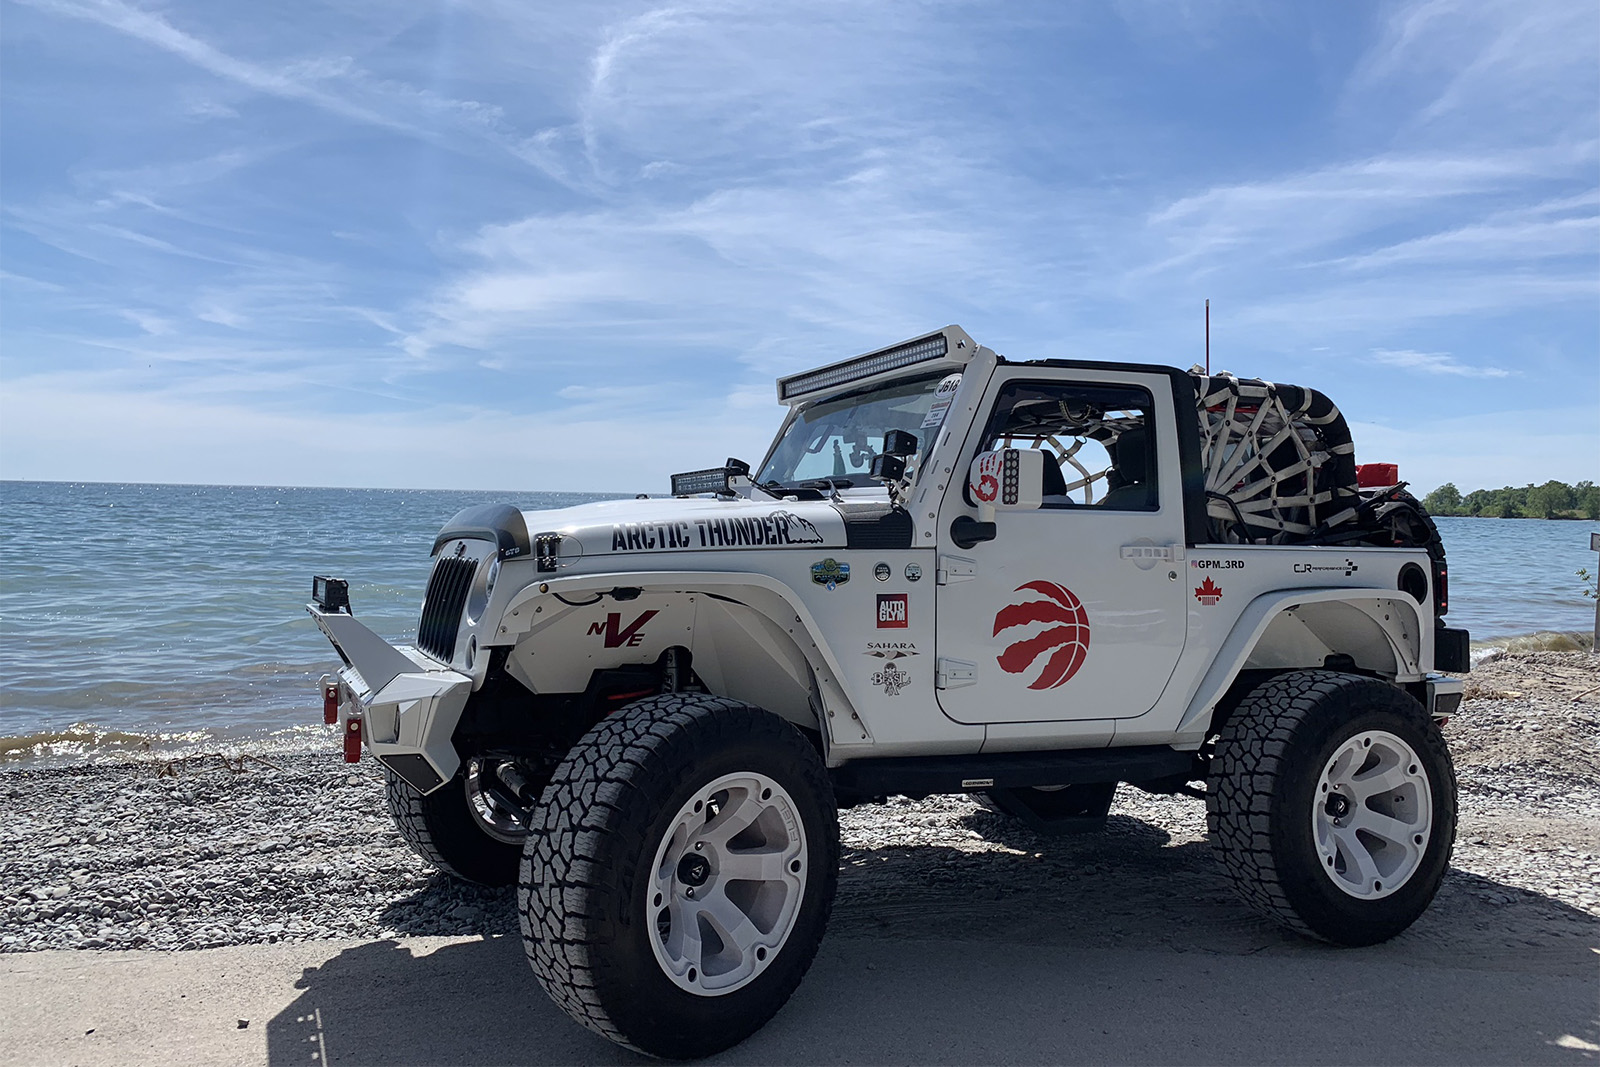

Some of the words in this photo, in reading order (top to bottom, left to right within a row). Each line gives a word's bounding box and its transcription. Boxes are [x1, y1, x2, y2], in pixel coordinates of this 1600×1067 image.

[612, 522, 690, 550] ARCTIC
[694, 516, 792, 547] THUNDER
[1198, 560, 1245, 569] GPM_3RD
[879, 601, 905, 612] AUTO
[879, 610, 906, 621] GLYM
[780, 801, 798, 841] FUEL
